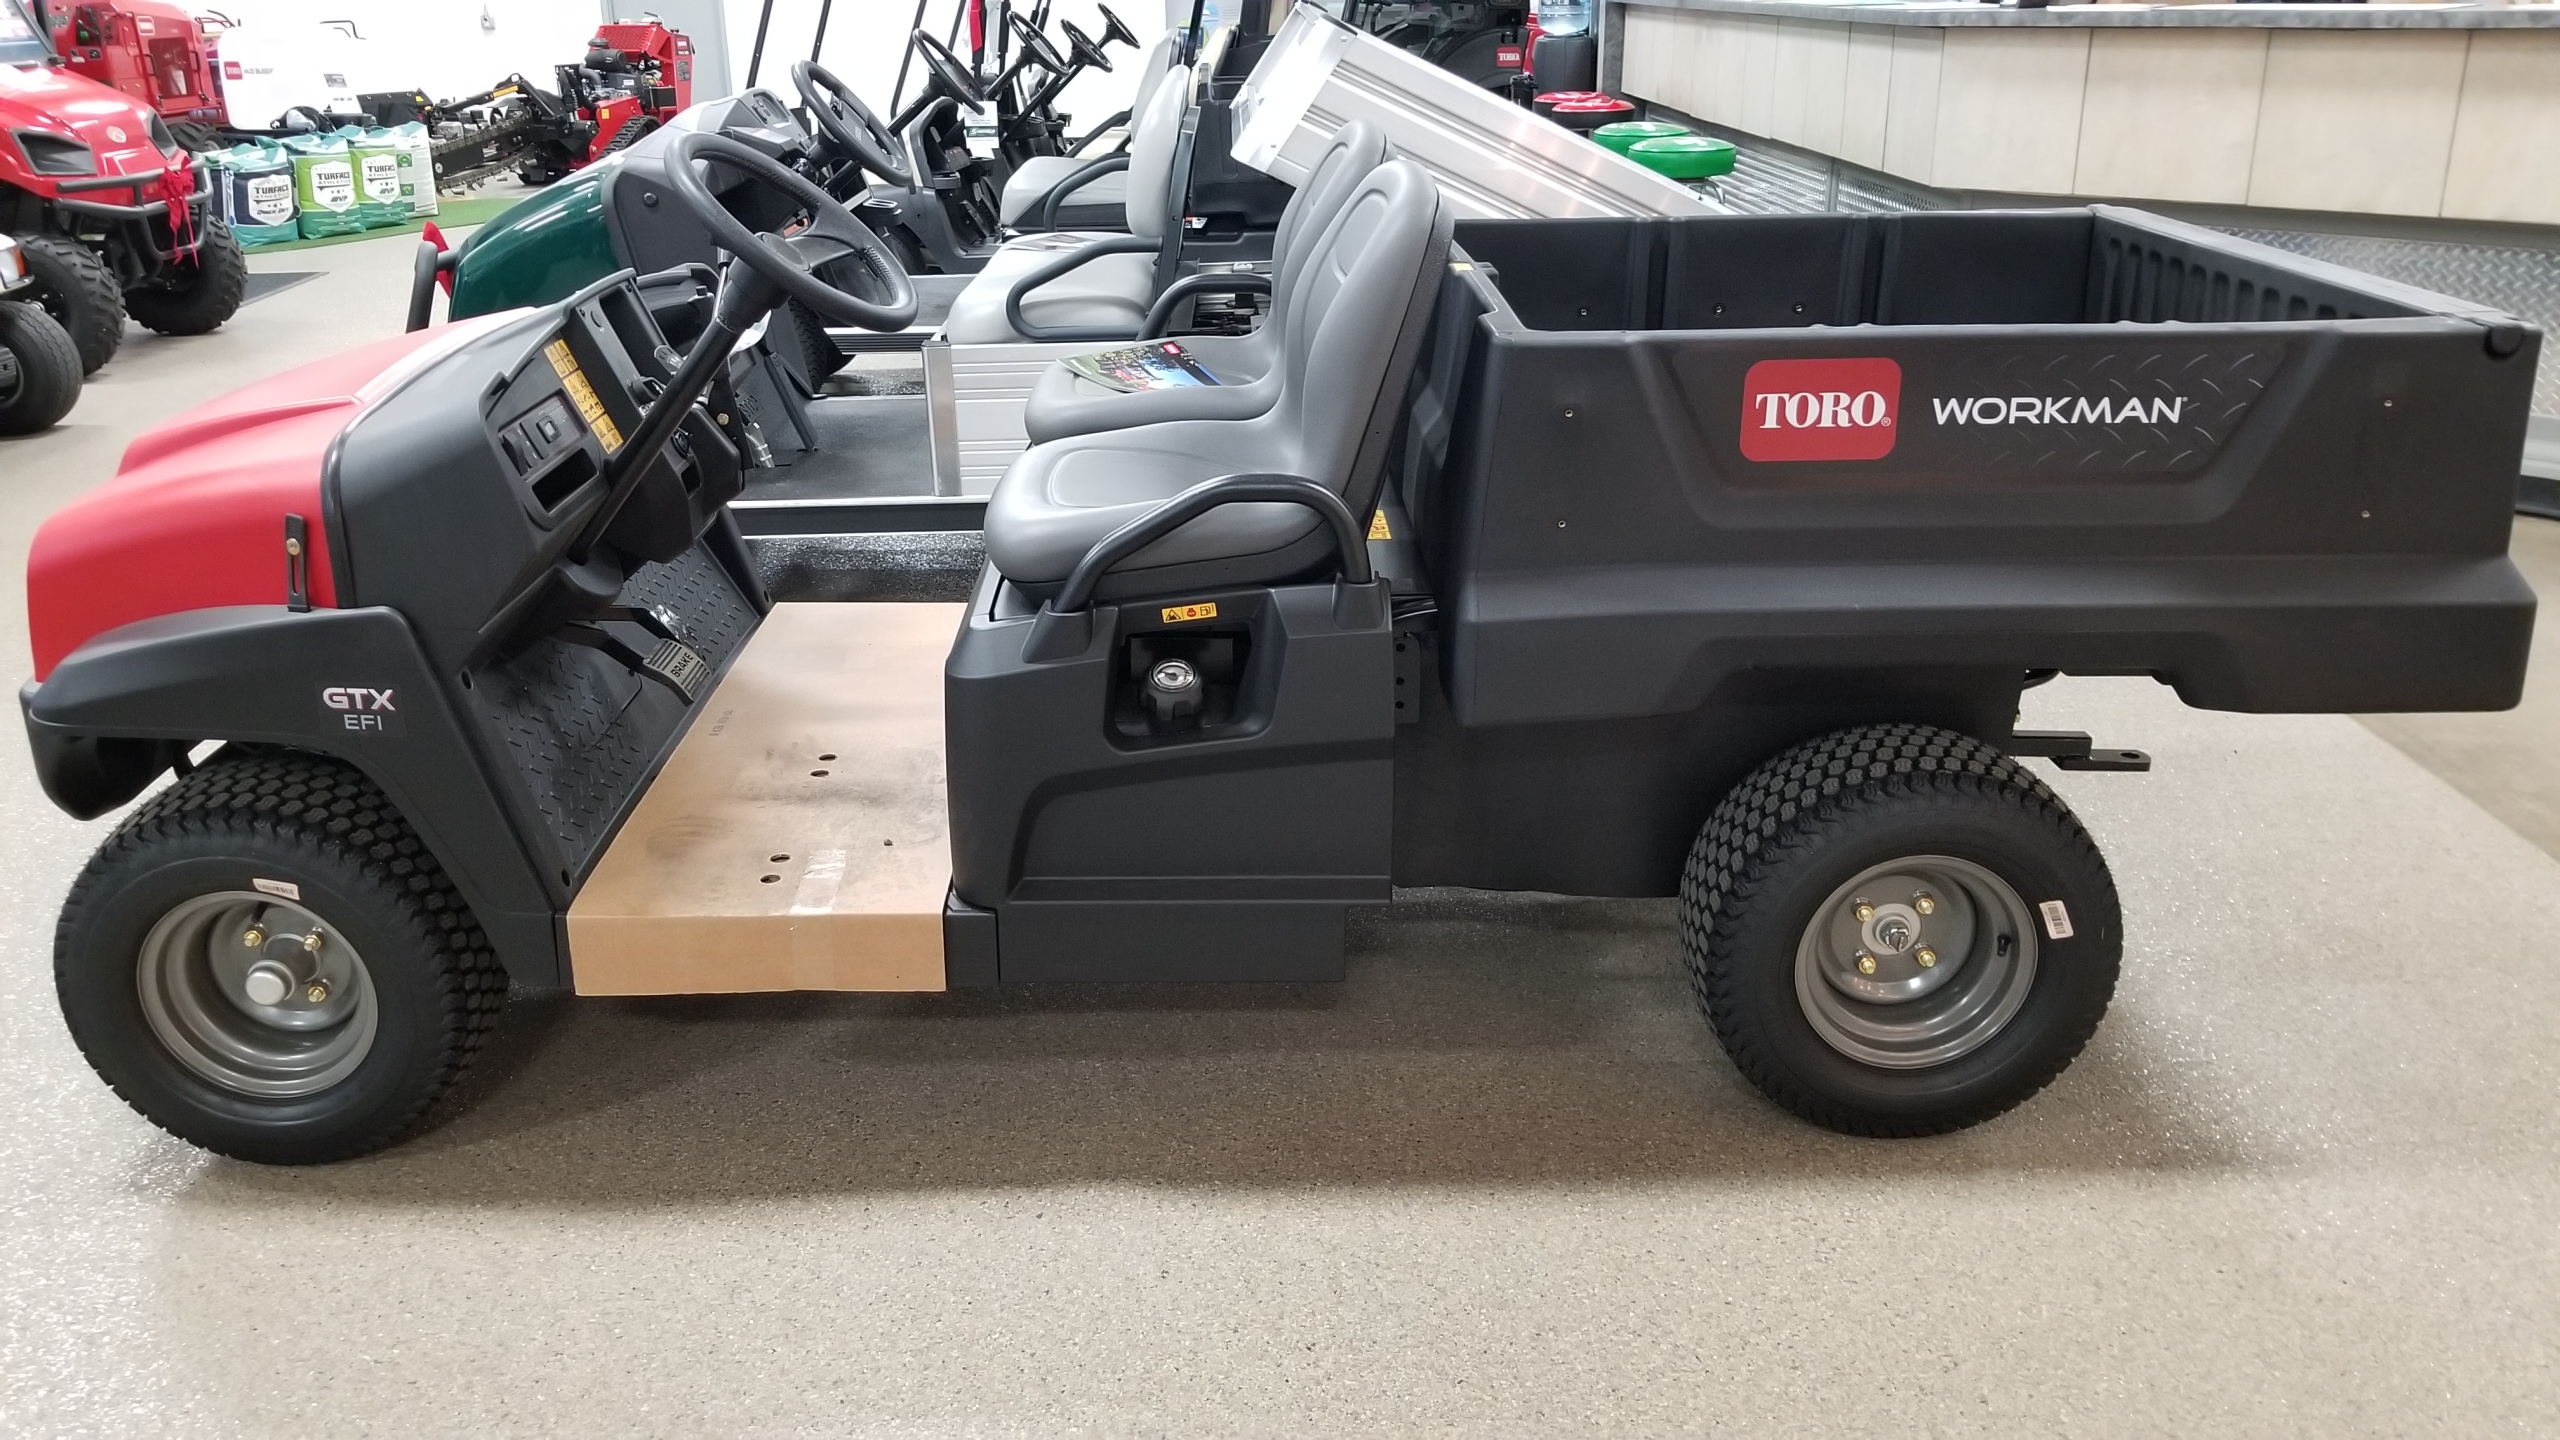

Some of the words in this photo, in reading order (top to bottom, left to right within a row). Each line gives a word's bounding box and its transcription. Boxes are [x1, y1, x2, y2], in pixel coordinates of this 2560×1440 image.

[1755, 390, 1887, 429] TORO
[1932, 396, 2184, 425] WORKMAN
[670, 651, 694, 678] BRAKE
[322, 687, 396, 711] GTX
[343, 713, 383, 731] EFI
